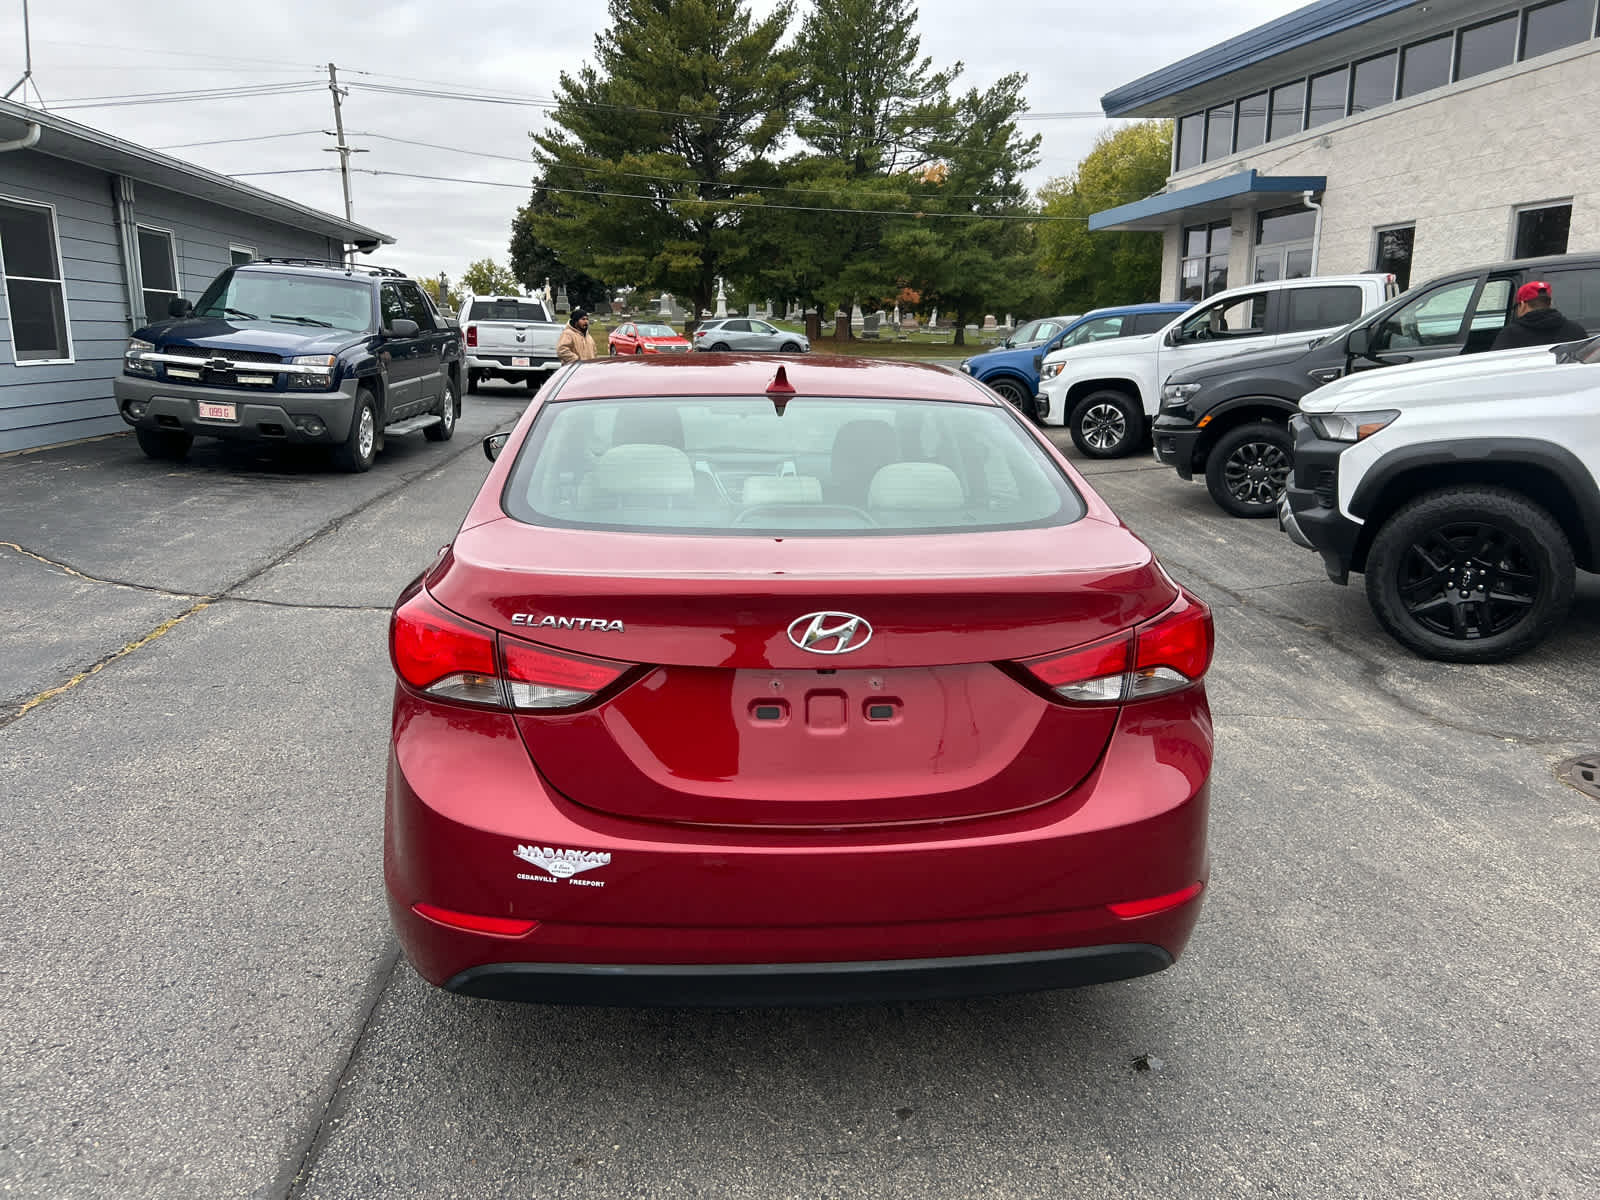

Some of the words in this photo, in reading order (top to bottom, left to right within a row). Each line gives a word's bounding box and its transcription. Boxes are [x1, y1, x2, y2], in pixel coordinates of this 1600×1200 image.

[511, 613, 625, 633] ELANTRA
[516, 873, 558, 883] CEDARVILLE
[569, 878, 605, 888] FREEPORT
